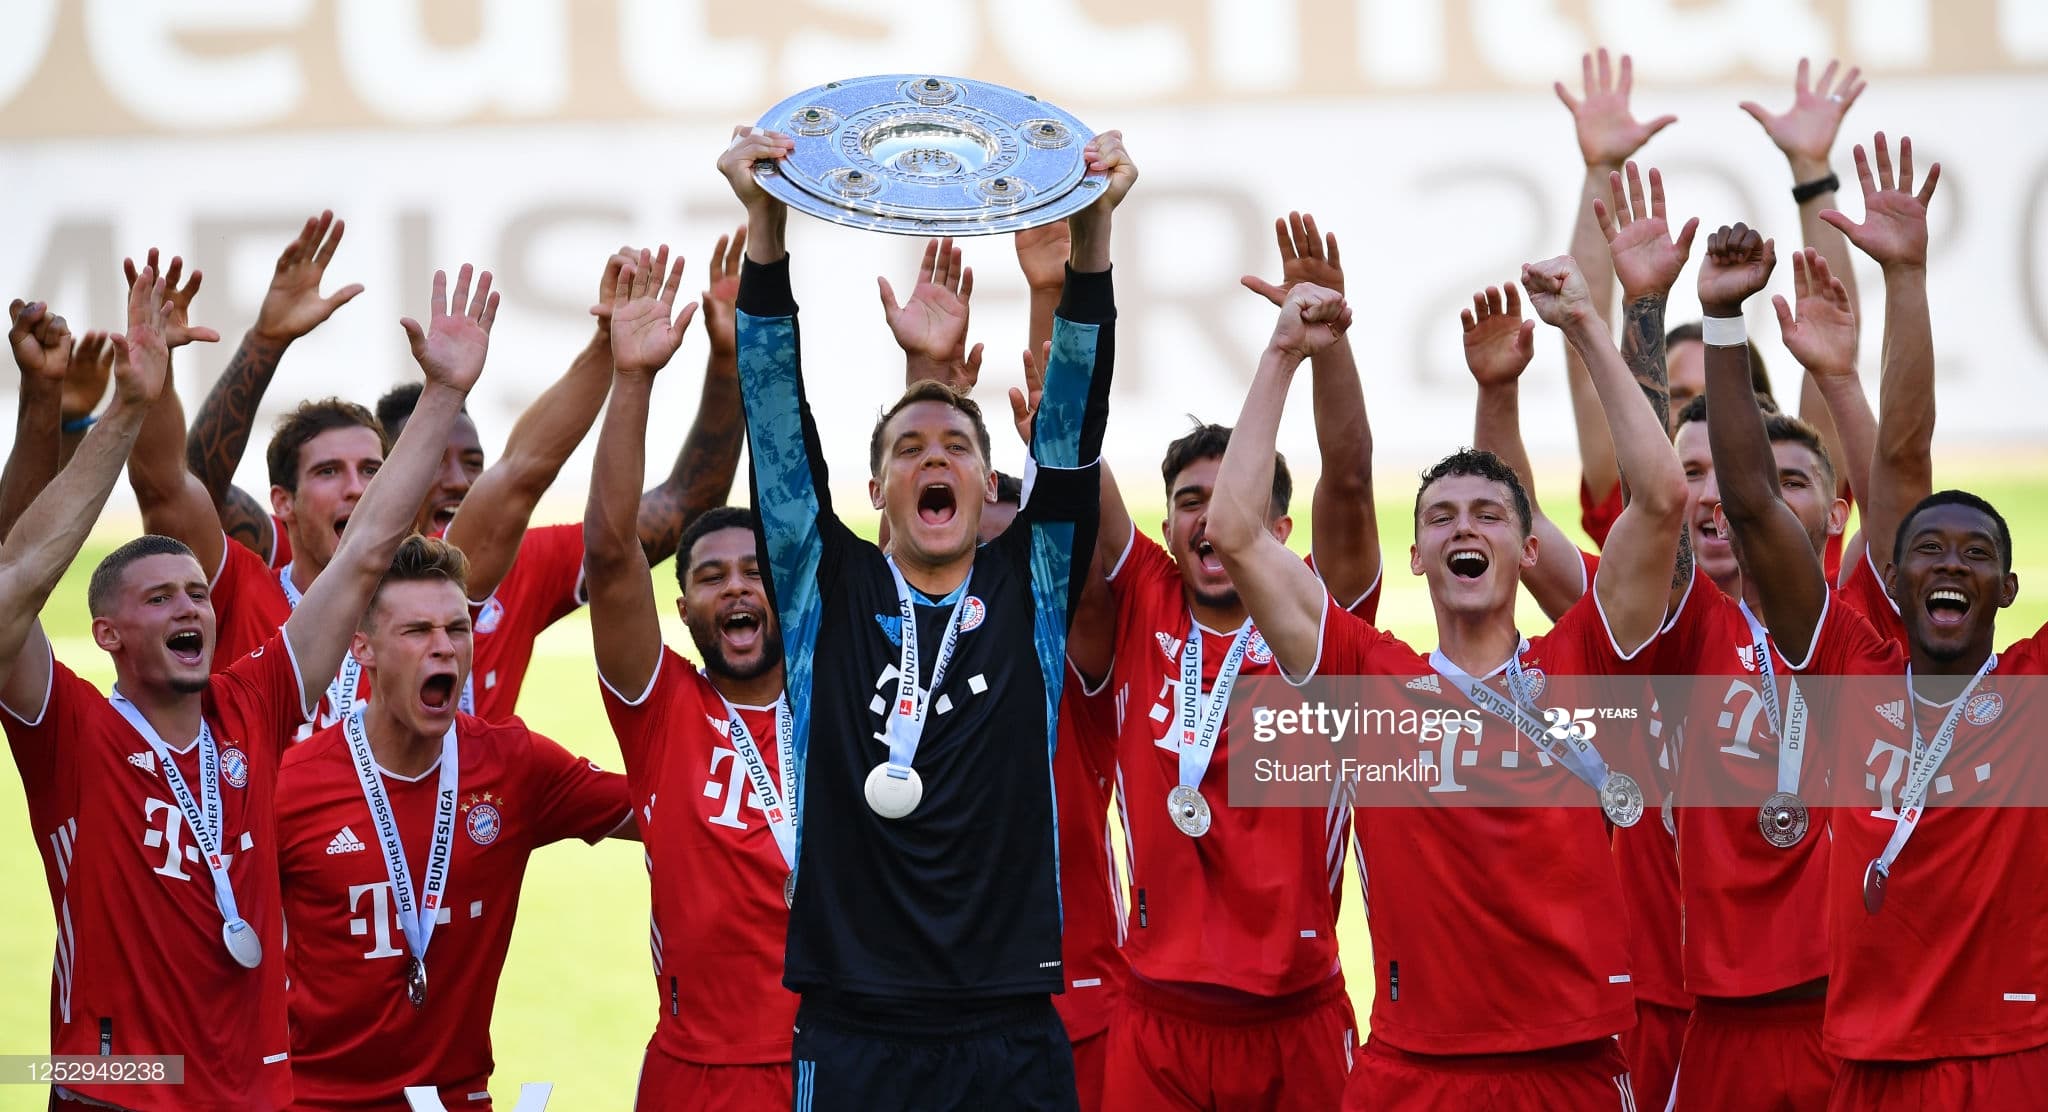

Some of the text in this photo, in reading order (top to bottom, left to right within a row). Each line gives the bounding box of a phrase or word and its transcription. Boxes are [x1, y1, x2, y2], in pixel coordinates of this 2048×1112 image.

[340, 656, 358, 720] BUNDES
[899, 598, 915, 696] BUNDESLIGA
[1184, 637, 1198, 729] BUNDESLIGA
[1200, 629, 1251, 748] DEUTSCHER FUSSBALL
[729, 719, 777, 807] BUNDESLIGA
[1788, 687, 1804, 750] DEUTSCHE
[162, 757, 215, 852] BUNDESLIGA
[351, 729, 394, 837] FUSSBALLMEISTER
[326, 841, 365, 855] adidas
[386, 838, 411, 912] DEUTSCHER
[429, 789, 454, 892] BUNDESLIGA
